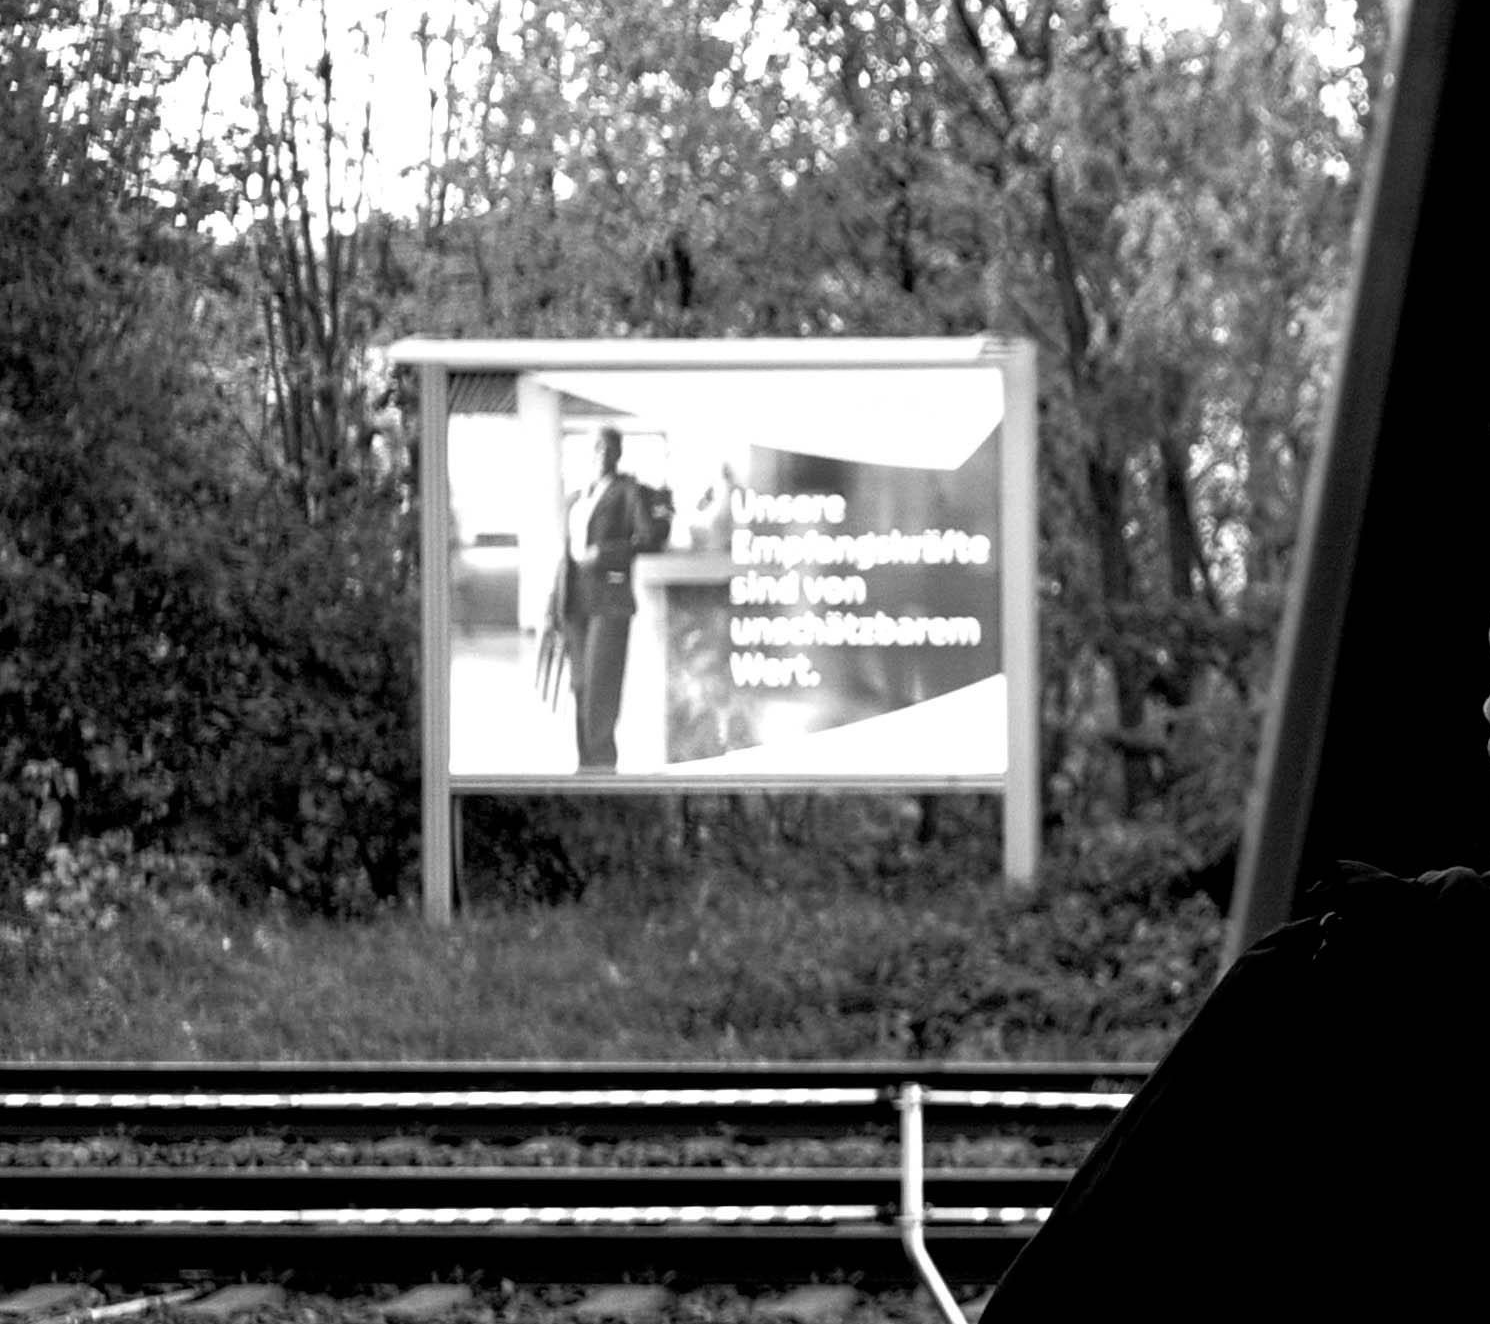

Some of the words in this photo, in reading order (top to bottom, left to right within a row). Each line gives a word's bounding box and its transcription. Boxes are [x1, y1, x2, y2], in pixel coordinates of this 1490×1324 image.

[731, 488, 845, 525] Unsere
[731, 570, 799, 605] sind
[803, 575, 867, 605] von
[730, 651, 821, 688] Wert.
